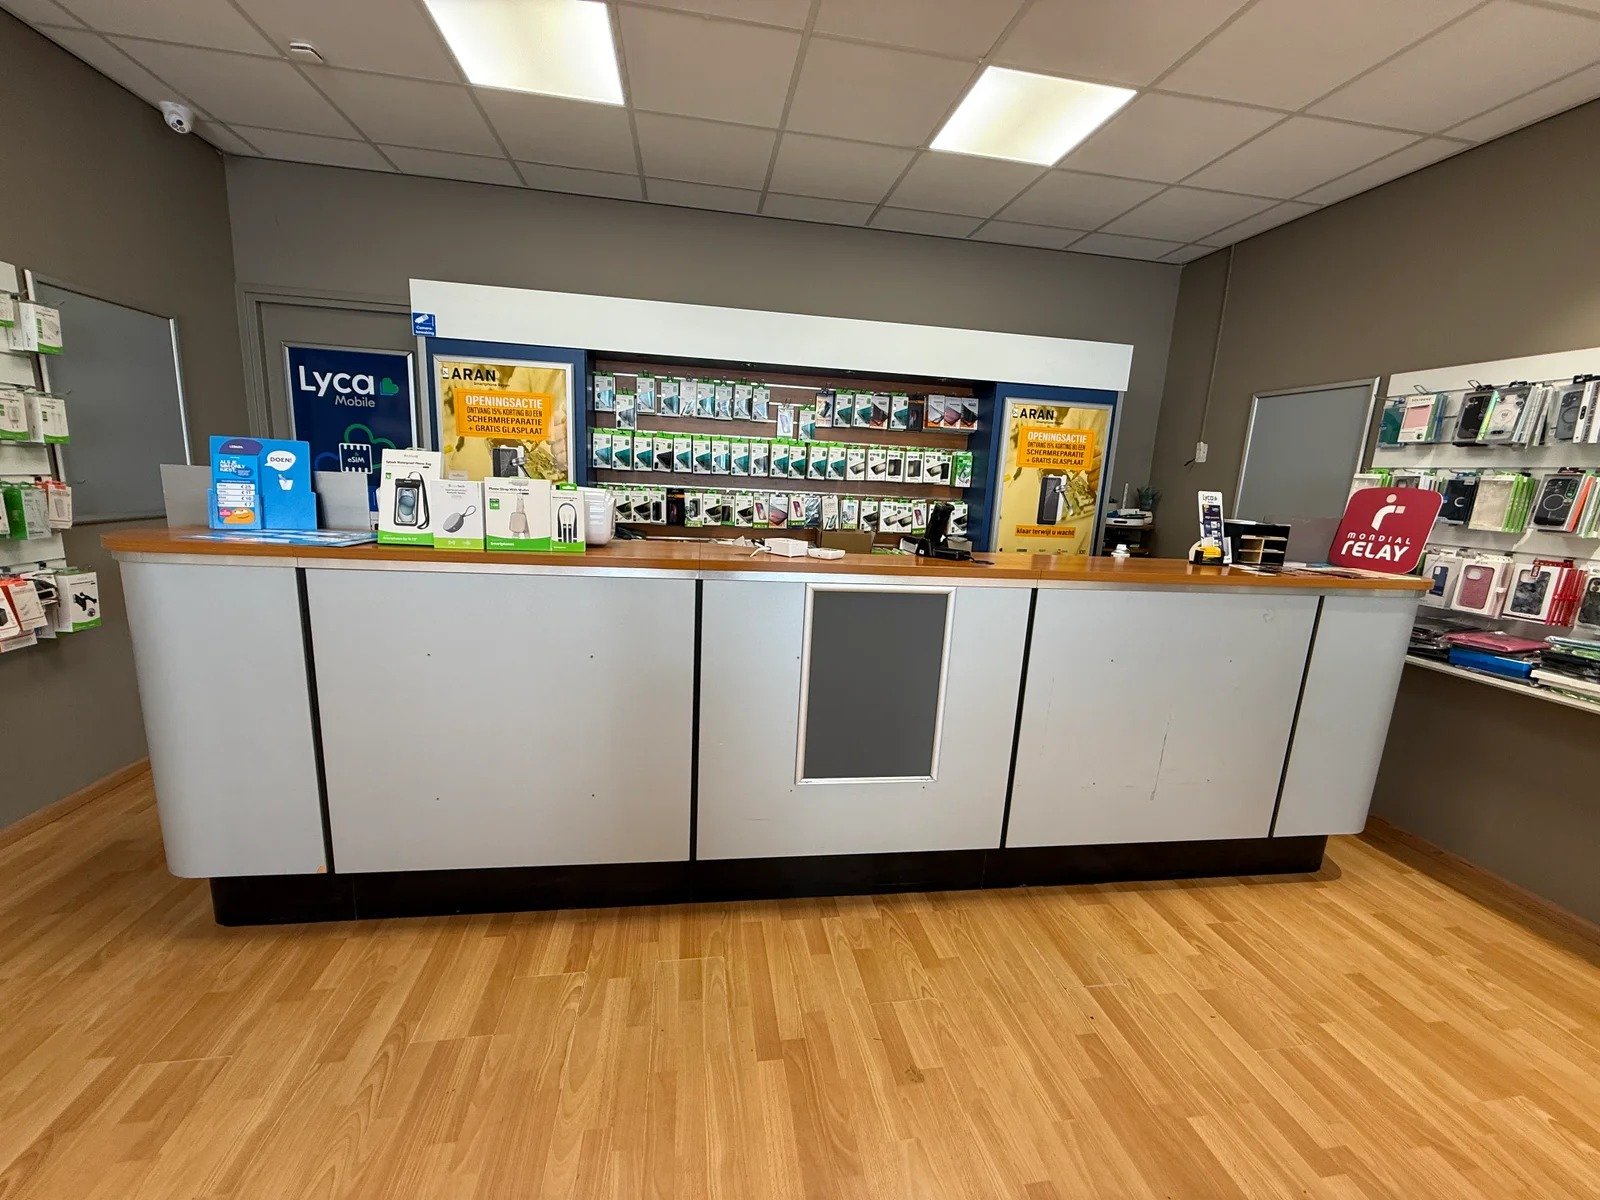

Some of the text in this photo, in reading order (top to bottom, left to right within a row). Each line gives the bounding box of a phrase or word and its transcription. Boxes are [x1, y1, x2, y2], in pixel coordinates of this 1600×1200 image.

[299, 365, 375, 397] Lyca
[451, 367, 496, 382] ARAN
[335, 395, 376, 408] Mobile
[465, 395, 543, 409] OPENINGSACTIE
[467, 406, 491, 414] ONTVANG
[491, 407, 502, 415] 15%
[503, 408, 524, 417] KORTING
[1020, 408, 1054, 421] ARAN
[467, 415, 543, 426] SCHERMREPARATIE
[502, 426, 542, 435] GLASPLAAT
[1027, 432, 1087, 443] OPENINGSACTIE
[1026, 449, 1084, 458] SCHERMREPARATIE
[1347, 532, 1411, 545] MONDIAL
[1340, 540, 1410, 562] RELAY
